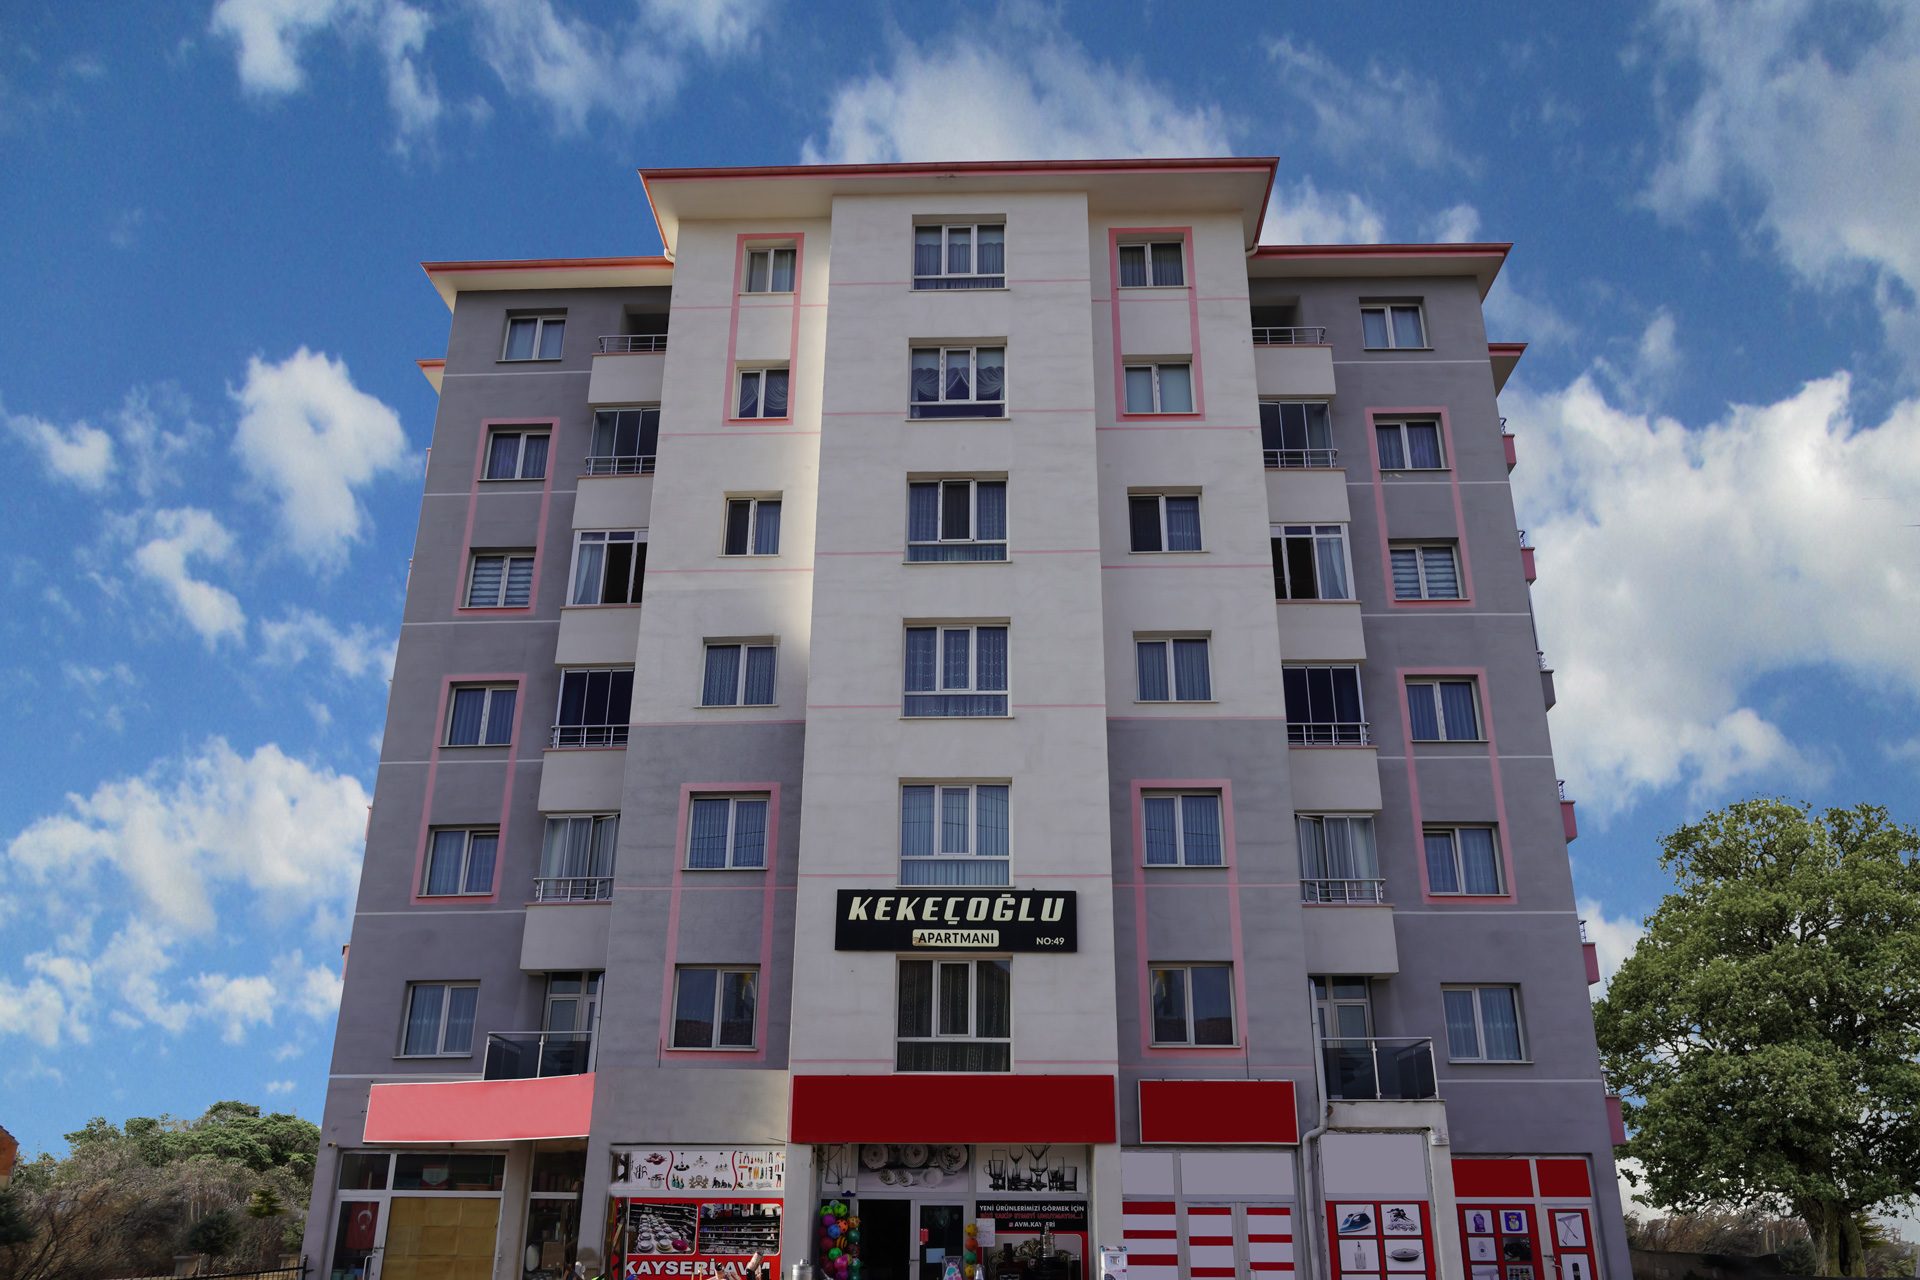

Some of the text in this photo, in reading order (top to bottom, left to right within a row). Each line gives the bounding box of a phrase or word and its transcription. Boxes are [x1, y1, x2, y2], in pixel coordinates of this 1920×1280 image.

[848, 894, 1064, 924] KEKEÇOĞLU
[918, 932, 994, 944] APARTMANI
[1036, 937, 1065, 946] NO:49
[979, 1204, 994, 1212] YENİ
[1041, 1204, 1070, 1212] GÖRMEK
[1070, 1204, 1085, 1213] İÇİN
[1014, 1220, 1056, 1228] AVM.KAYERİ
[626, 1258, 716, 1275] KAYSERİ
